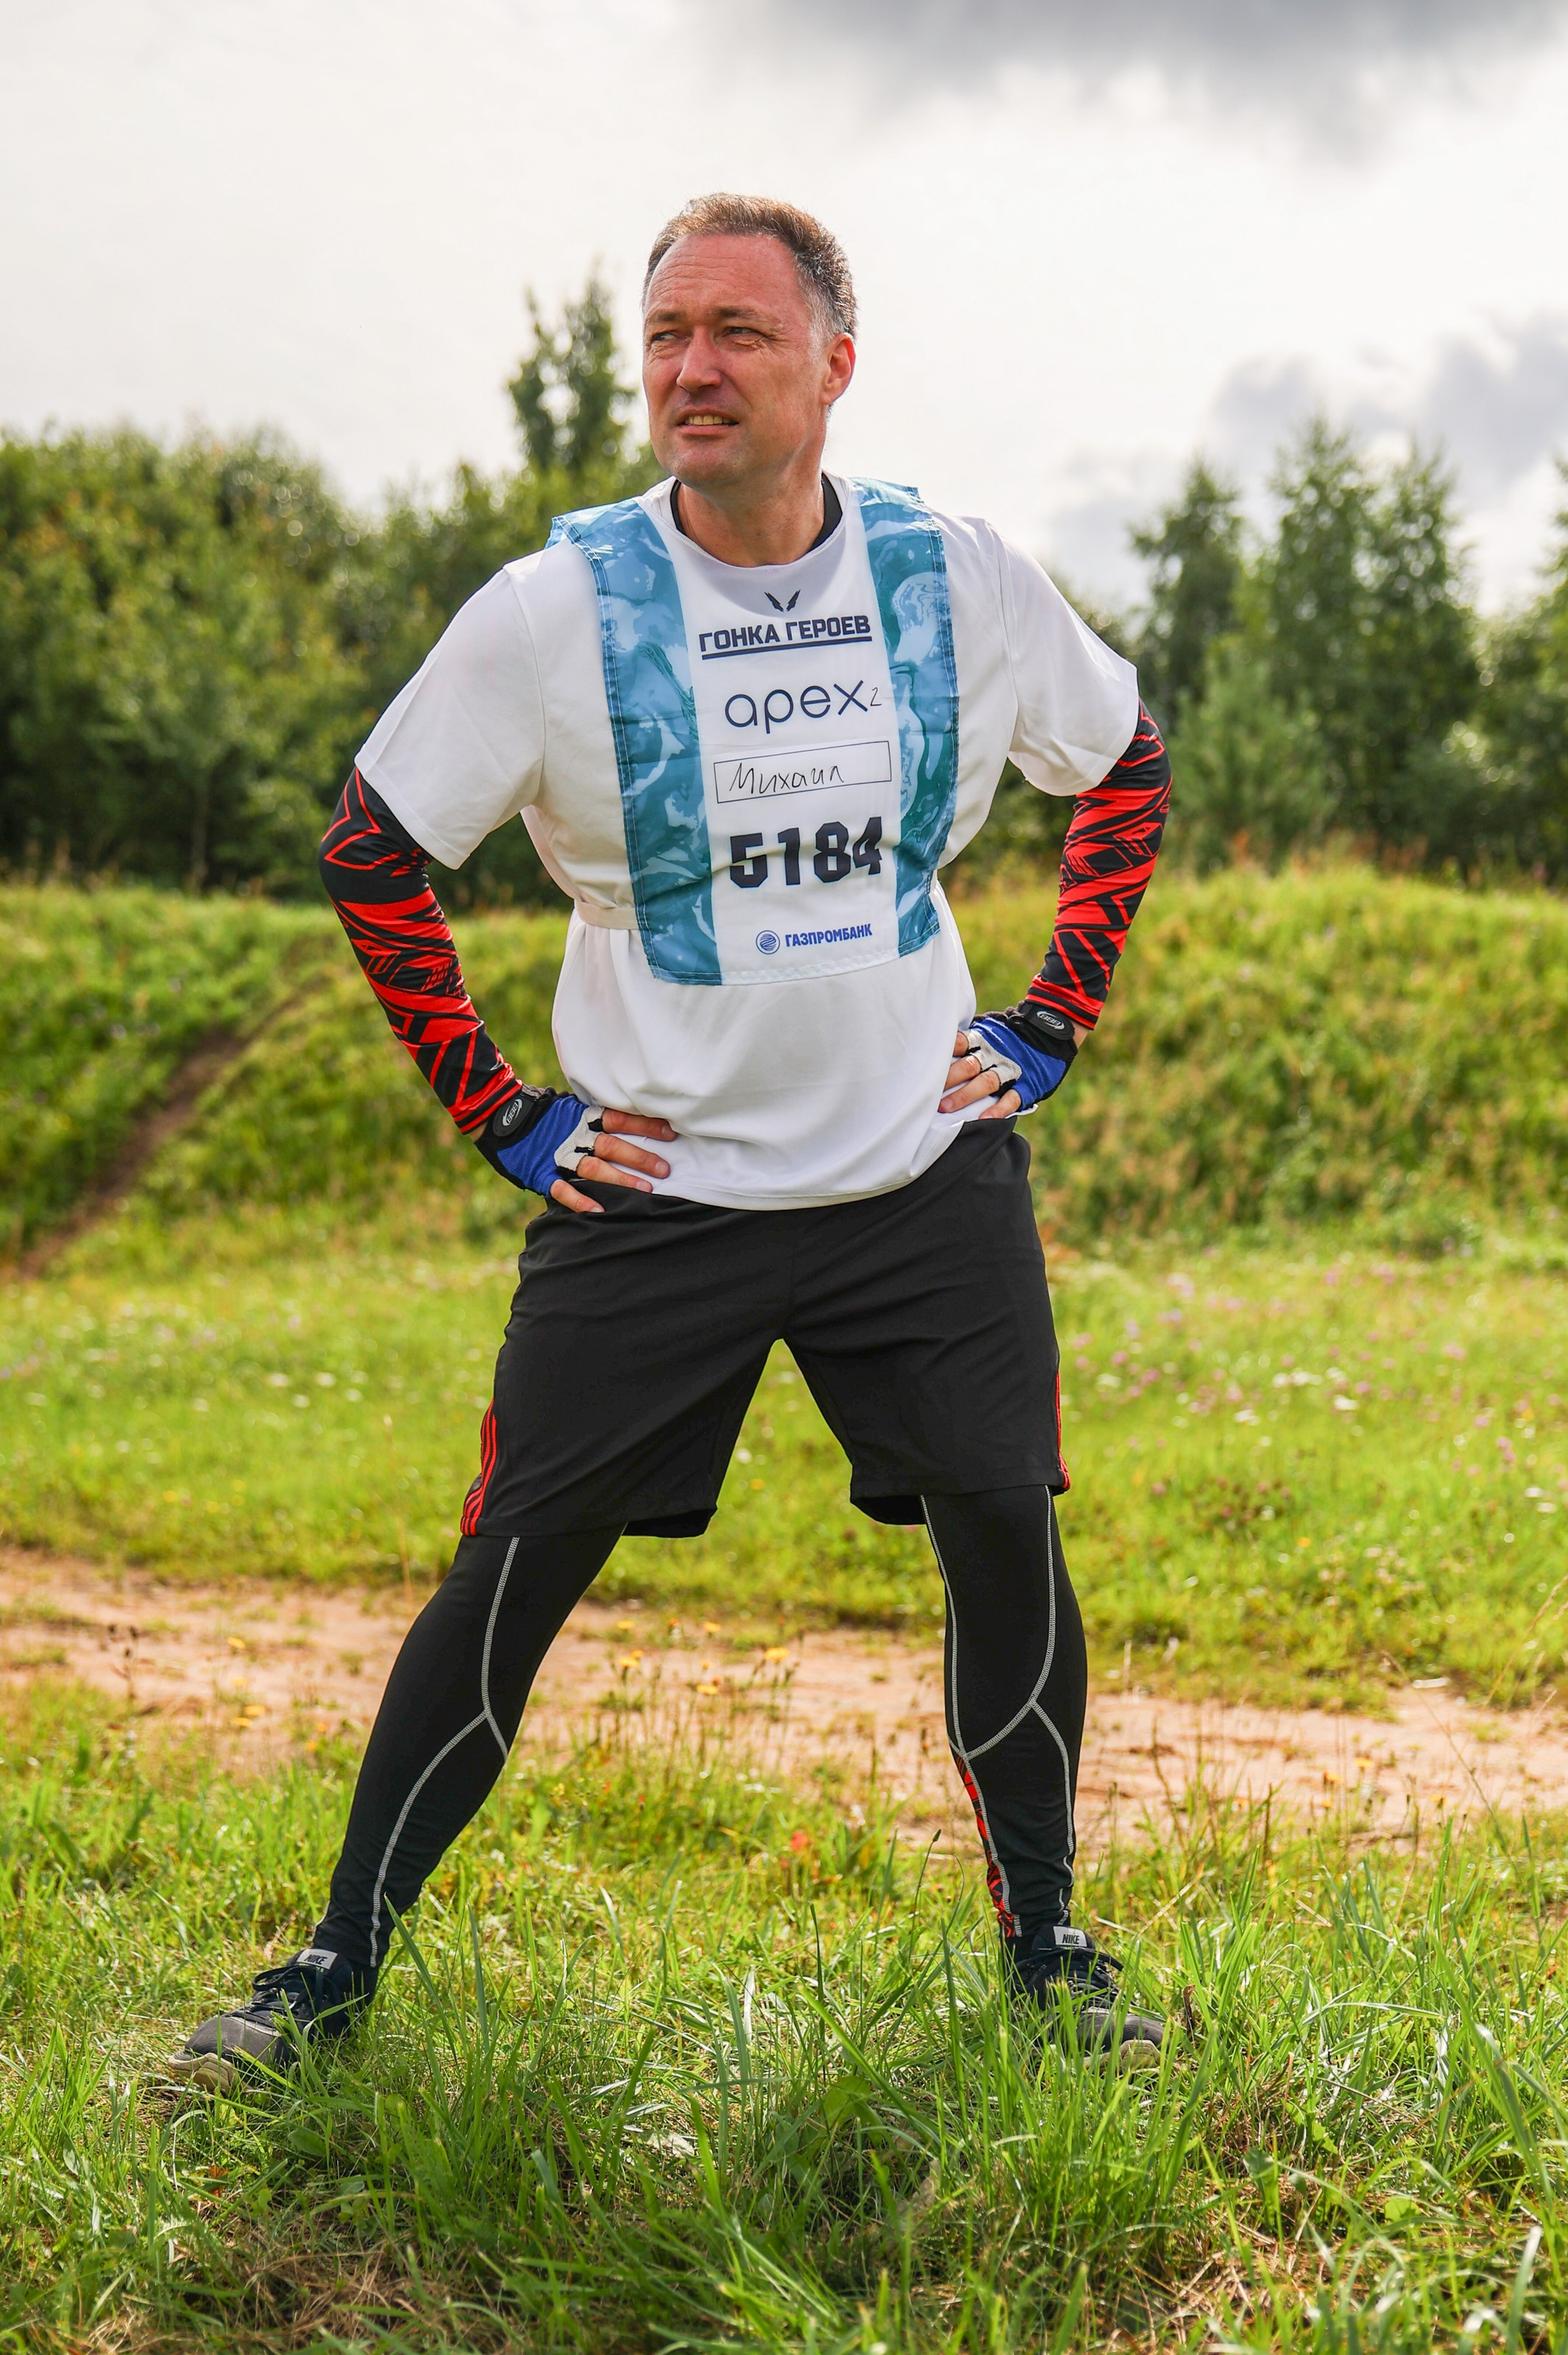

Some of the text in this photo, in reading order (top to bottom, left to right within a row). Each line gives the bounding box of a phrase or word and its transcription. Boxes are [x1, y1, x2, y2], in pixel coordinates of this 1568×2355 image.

[699, 615, 871, 652] ГОНКА ГЕРОЕВ
[725, 679, 868, 734] apex
[728, 762, 845, 795] Михаил
[729, 815, 882, 889] 5184
[784, 923, 873, 947] ГАЗПРОМБАНК
[1062, 1933, 1079, 1945] NIKE
[303, 1953, 328, 1965] NIKE
